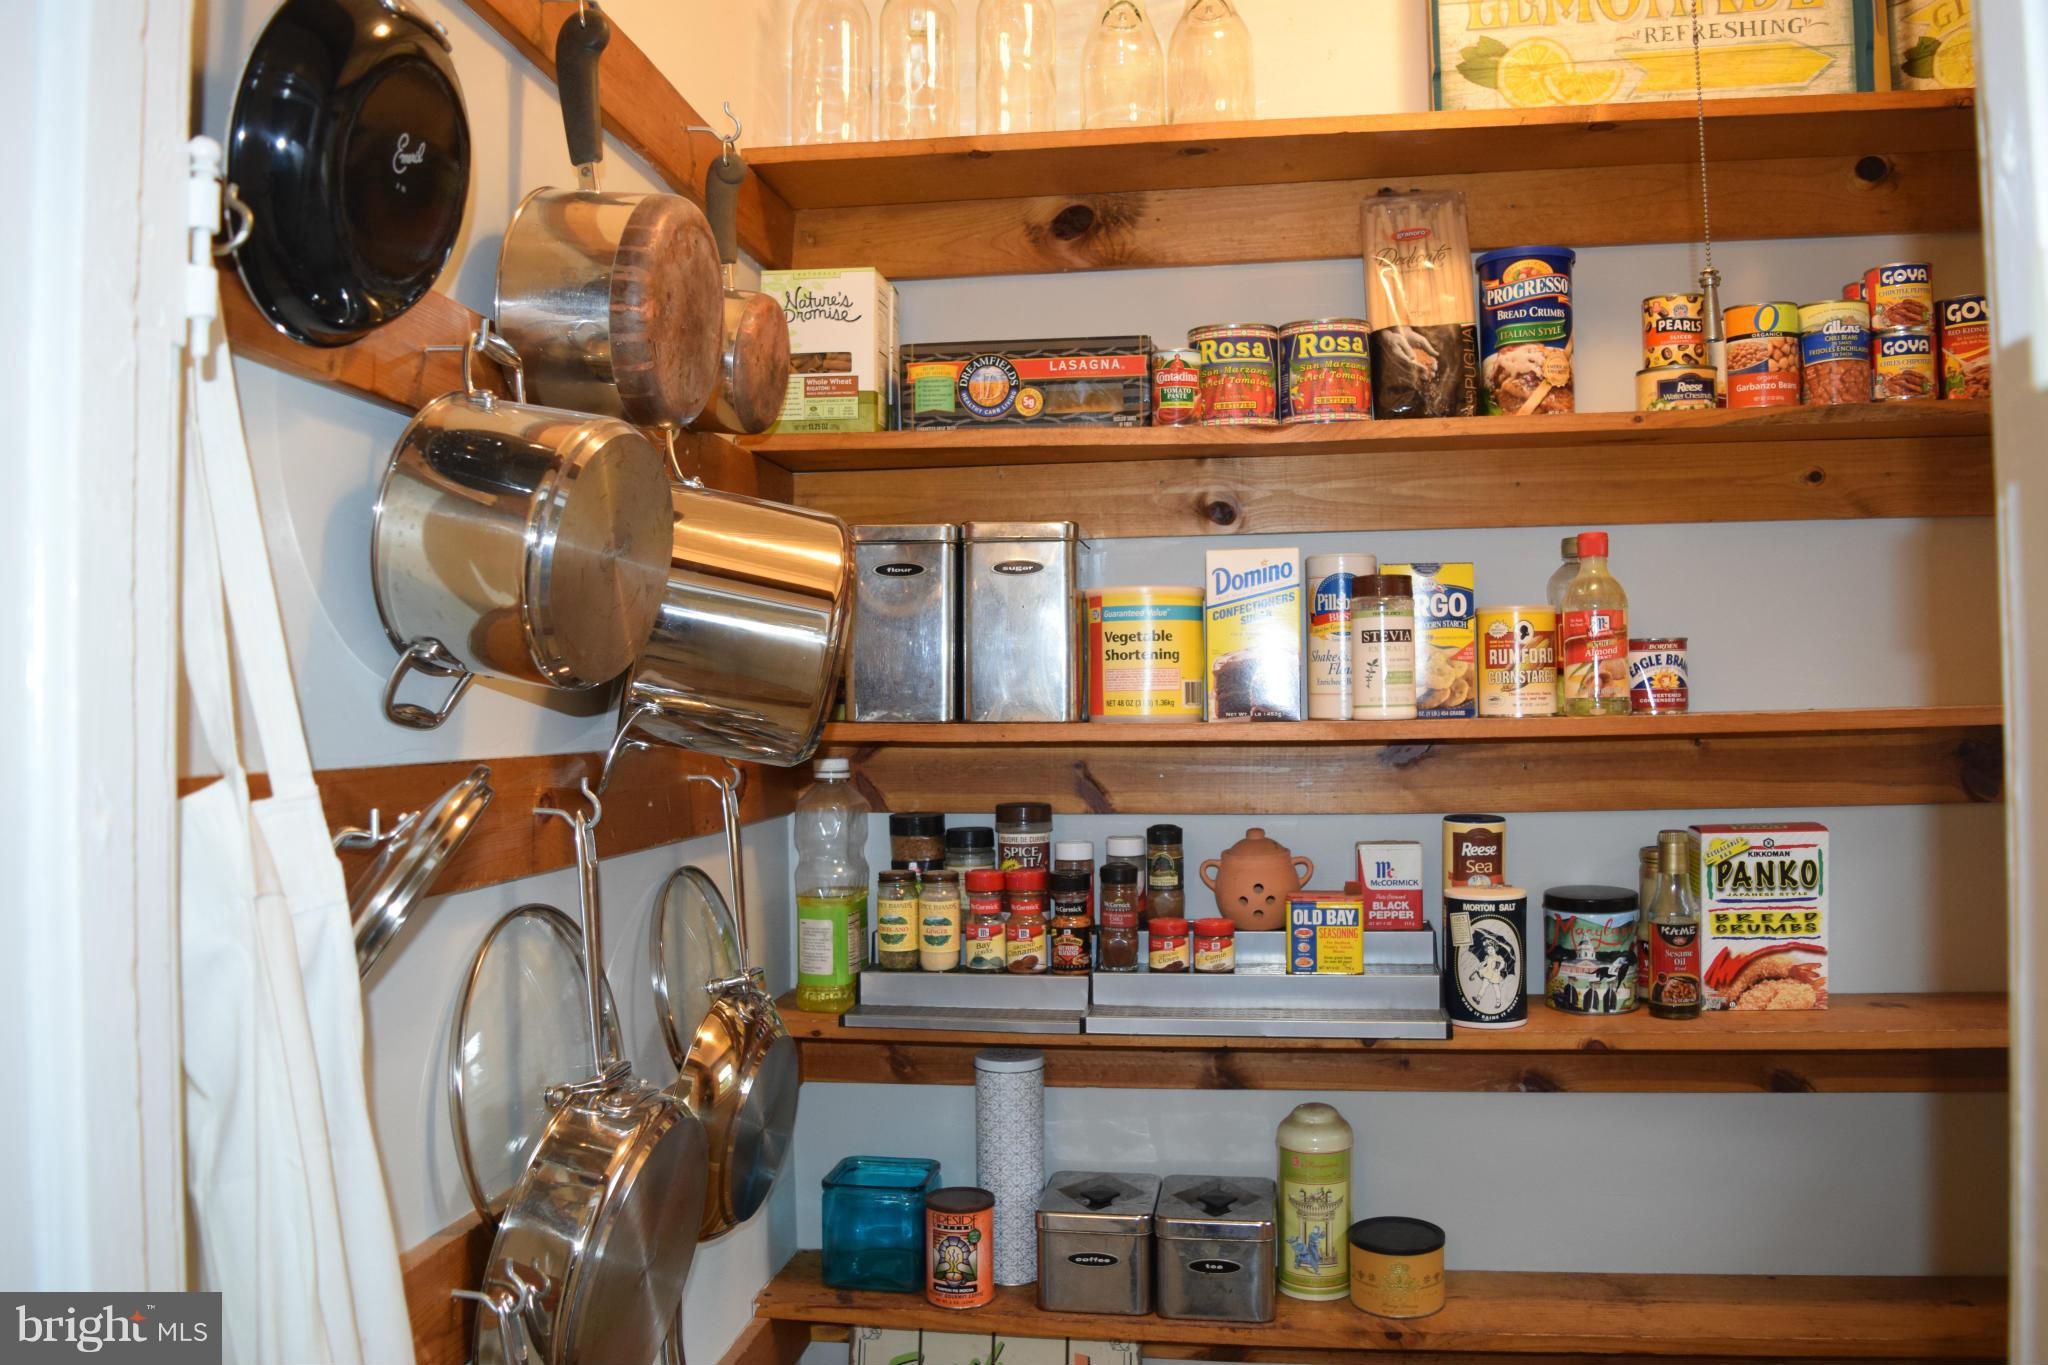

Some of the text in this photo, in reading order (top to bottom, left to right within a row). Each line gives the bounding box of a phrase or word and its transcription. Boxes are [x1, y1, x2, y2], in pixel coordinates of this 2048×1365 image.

[1644, 17, 1802, 44] REFRESHING
[1881, 267, 1928, 285] GOYA
[784, 285, 854, 311] Nature's
[1487, 276, 1569, 306] PROGRESSO
[1497, 306, 1566, 321] BREAD CRUMBS
[1500, 325, 1562, 340] ITALIAN STYLE
[1657, 318, 1702, 333] PEARLS
[1200, 339, 1268, 364] Rosa
[1298, 333, 1367, 359] Rosa
[1882, 339, 1929, 356] GOYA
[959, 355, 1019, 388] DREAMFIELDS
[1049, 359, 1121, 371] LASAGNA
[829, 377, 852, 385] Wheat
[1156, 370, 1198, 384] Contadina
[1163, 387, 1192, 395] TOMATO
[1676, 381, 1703, 393] Reese
[1736, 382, 1777, 393] Garbanzo
[886, 566, 913, 574] flour
[1002, 564, 1034, 573] sugar
[1212, 562, 1293, 595] Domino
[1212, 592, 1296, 622] CONFECTIONERS
[1317, 592, 1351, 612] Pillsb
[1416, 592, 1468, 618] RGO
[1240, 610, 1272, 625] SUR
[1442, 619, 1467, 629] STARCH
[1104, 630, 1173, 646] Vegetable
[1363, 630, 1411, 643] STEVIA
[1105, 648, 1180, 663] Shortening
[1585, 646, 1618, 657] Almond
[1629, 653, 1689, 678] EAGLE BRAN
[1317, 677, 1342, 687] Enriche
[1488, 668, 1556, 685] CORN STARCH
[1003, 846, 1039, 859] SPICE
[1461, 842, 1497, 857] Reese
[1747, 850, 1791, 858] KIKKOMAN
[1465, 859, 1493, 874] Sea
[1716, 858, 1818, 890] PANKO
[1370, 879, 1419, 887] McCORMICK
[1372, 901, 1409, 911] BLACK
[1462, 902, 1516, 912] MORTON SALT
[1293, 909, 1355, 926] OLD BAY
[1369, 910, 1415, 920] PEPPER
[1715, 912, 1818, 924] BREAD
[1318, 927, 1359, 940] SEASONING
[1550, 912, 1633, 952] Marylan
[1715, 922, 1817, 935] CRUMBS
[1664, 949, 1694, 957] Sesame
[1673, 958, 1686, 967] Oil
[1074, 1255, 1111, 1265] coffee
[1204, 1262, 1224, 1270] tea
